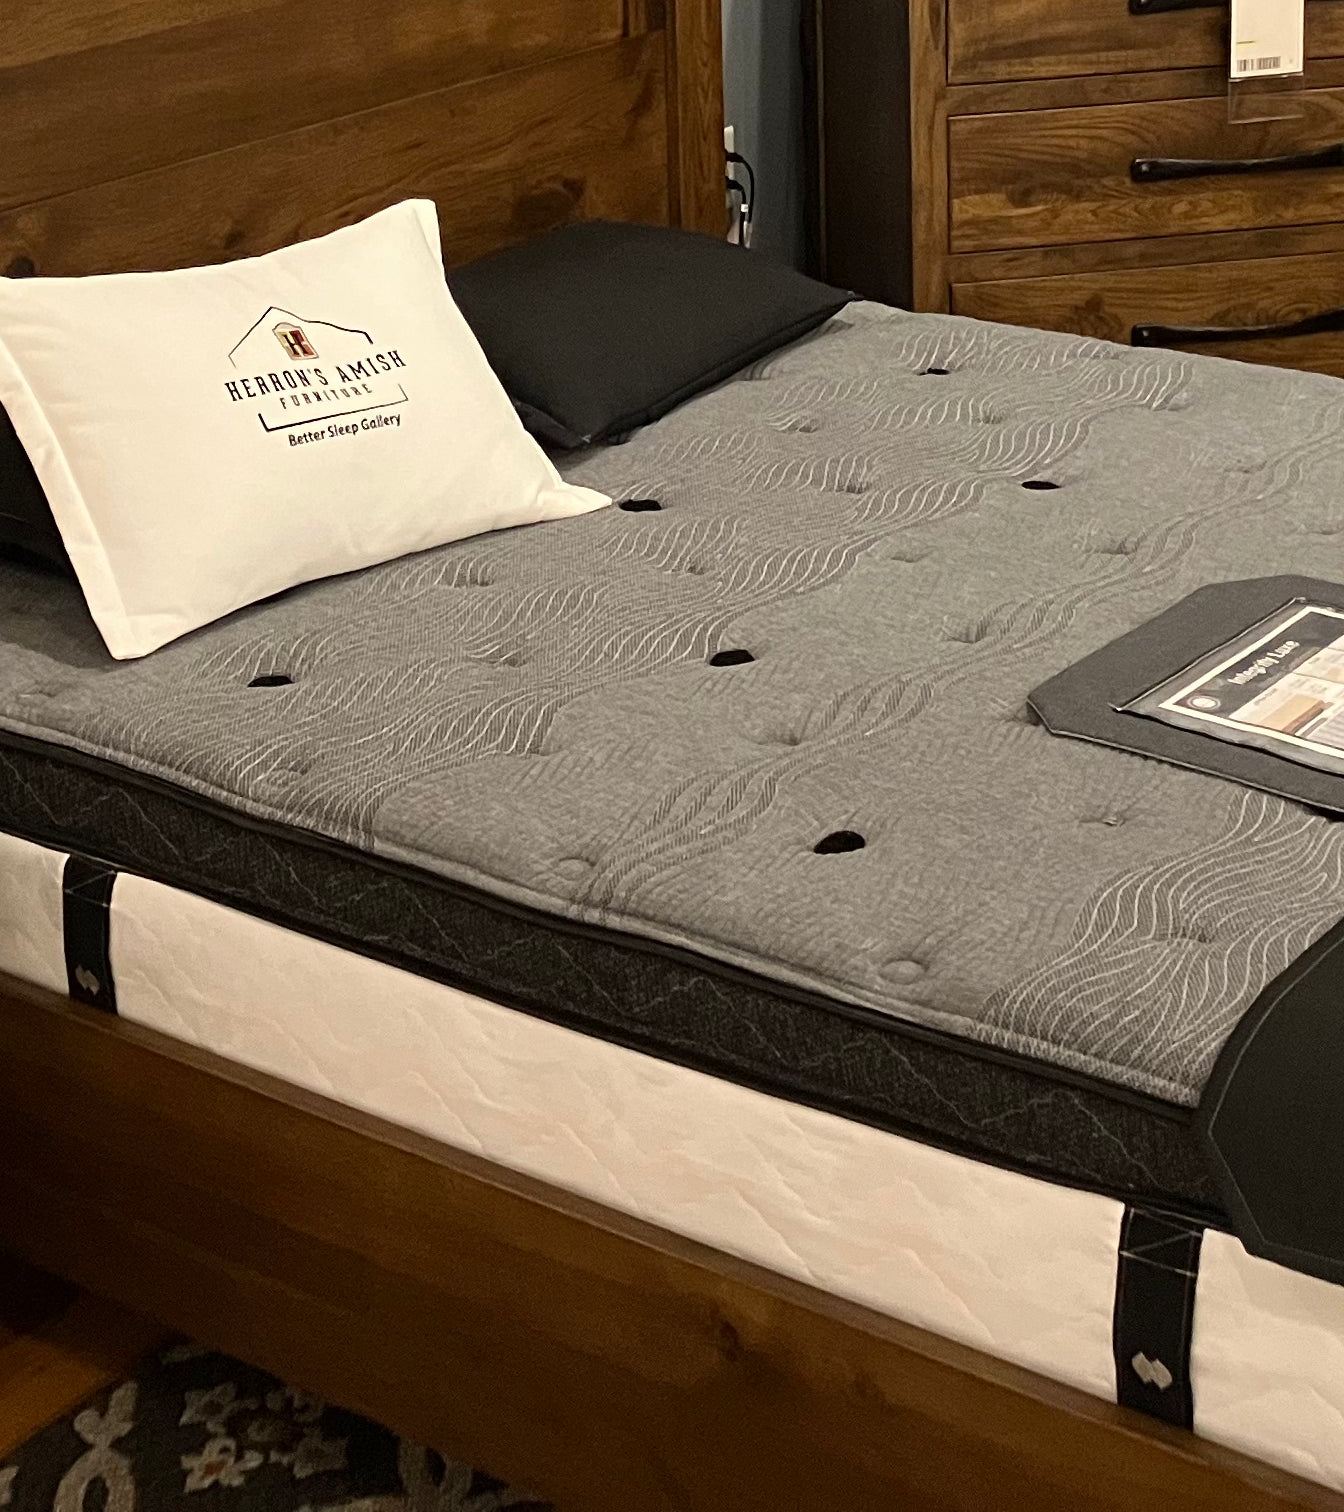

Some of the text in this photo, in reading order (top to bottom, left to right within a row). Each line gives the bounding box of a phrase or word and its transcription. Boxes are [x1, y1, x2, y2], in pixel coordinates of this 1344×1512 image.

[224, 350, 407, 402] HERRON'S AMISH
[280, 383, 373, 410] FURNITURE
[288, 413, 401, 447] Better Sleep Gallery
